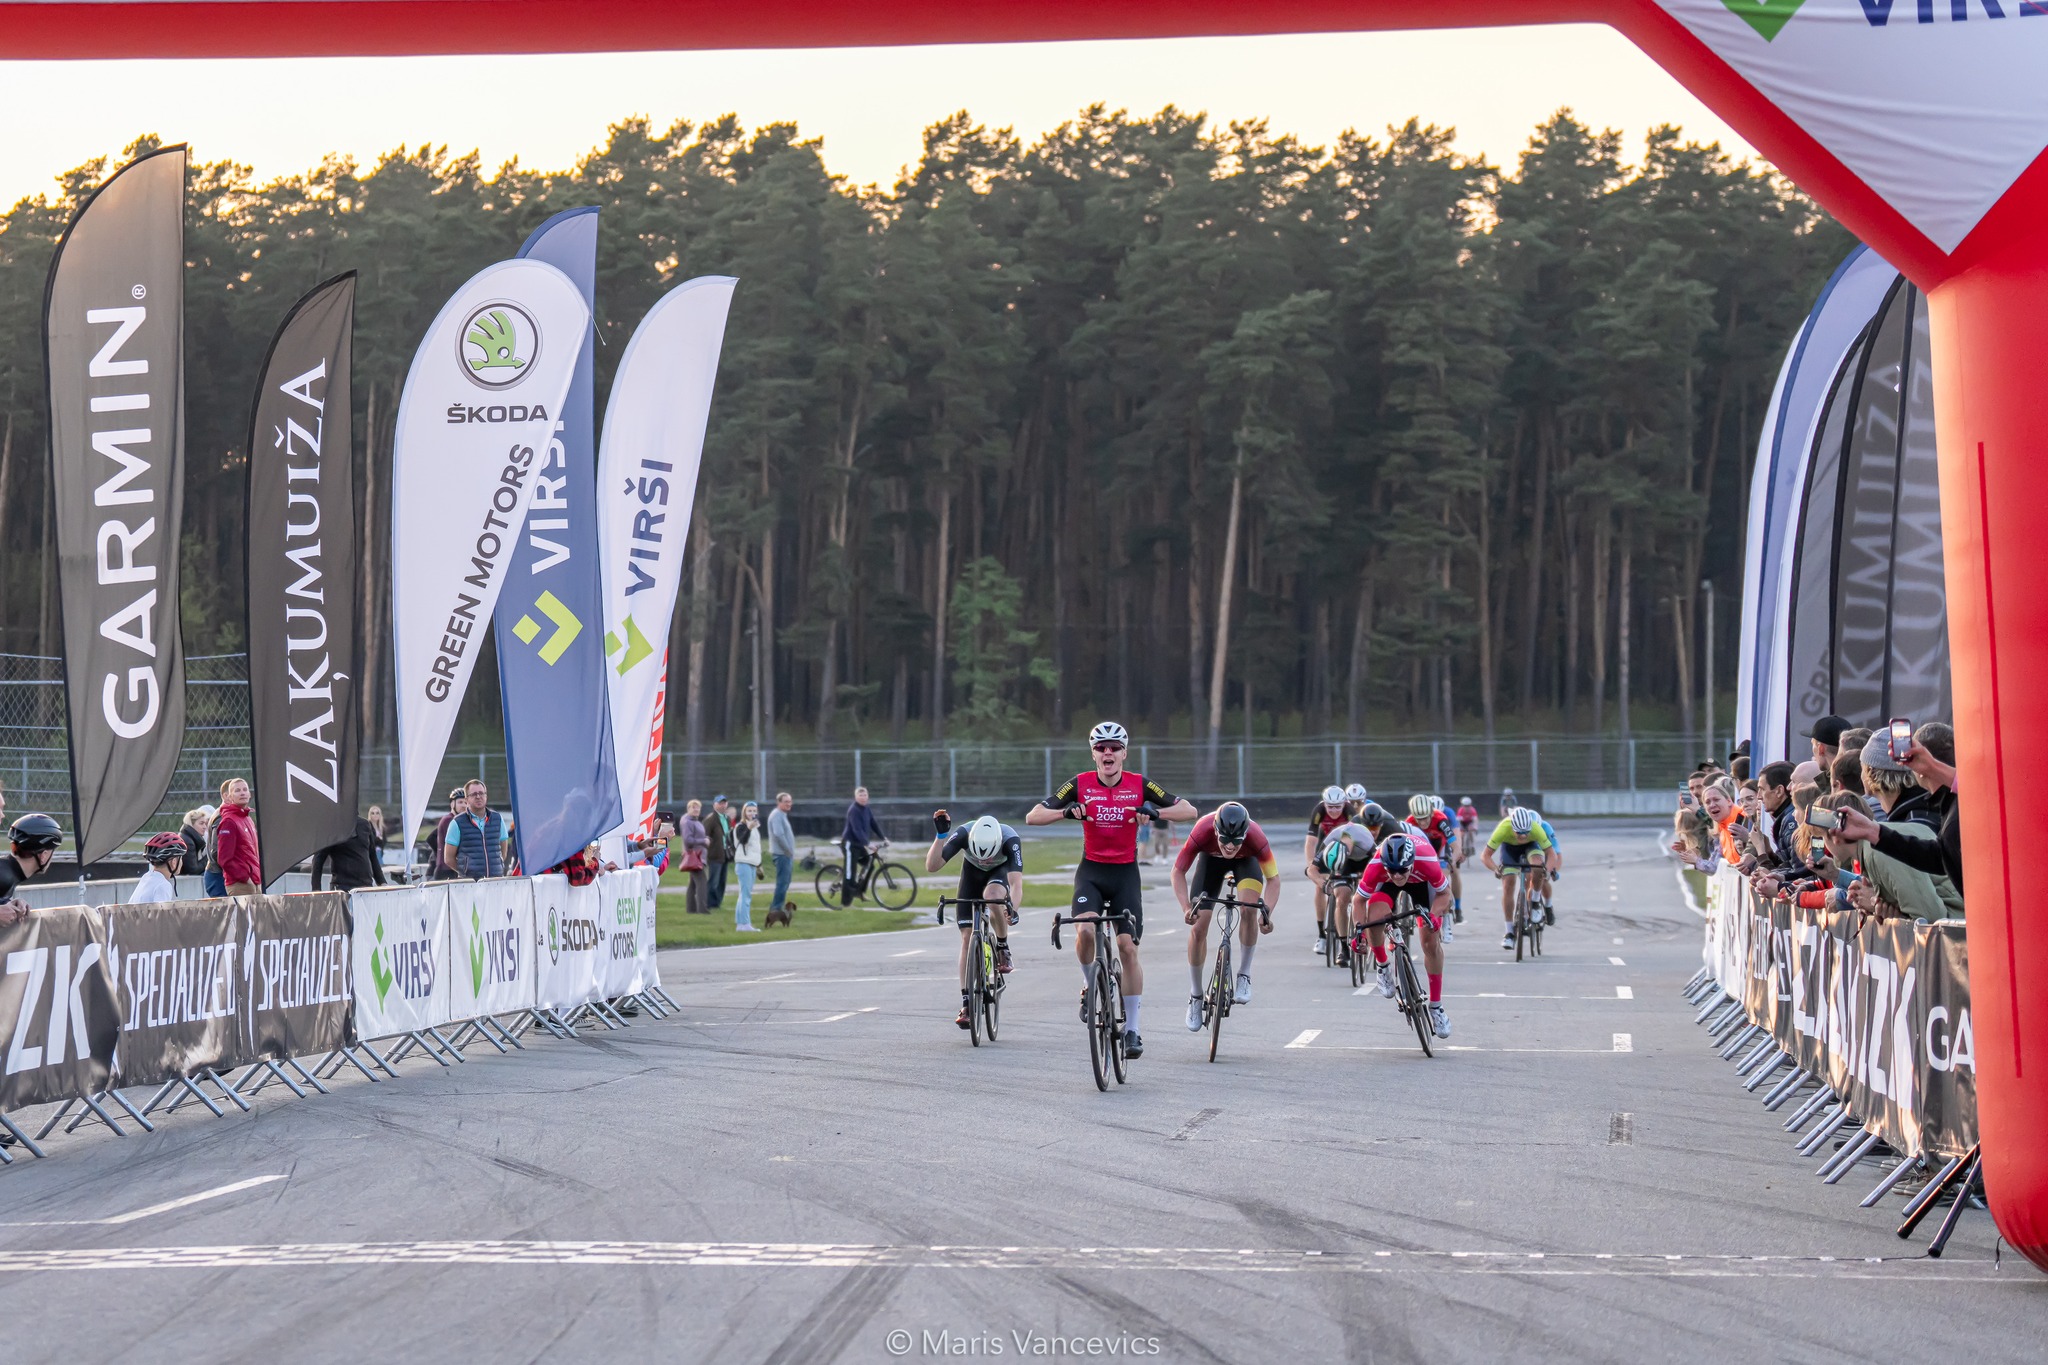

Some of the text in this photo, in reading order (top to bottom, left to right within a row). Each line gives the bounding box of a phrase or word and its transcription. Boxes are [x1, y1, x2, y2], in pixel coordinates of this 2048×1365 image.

[447, 402, 549, 424] ŠKODA
[623, 458, 673, 597] VIRŠI
[275, 357, 349, 804] ZAĶUMUIŽA
[425, 444, 534, 703] GREEN MOTORS
[1096, 805, 1125, 814] Tartu
[1096, 814, 1124, 822] 2024
[393, 918, 436, 1000] VIRŠI
[561, 911, 599, 951] ŠKODA
[5, 942, 102, 1076] ZK
[124, 942, 237, 1032] SPECIALIZED
